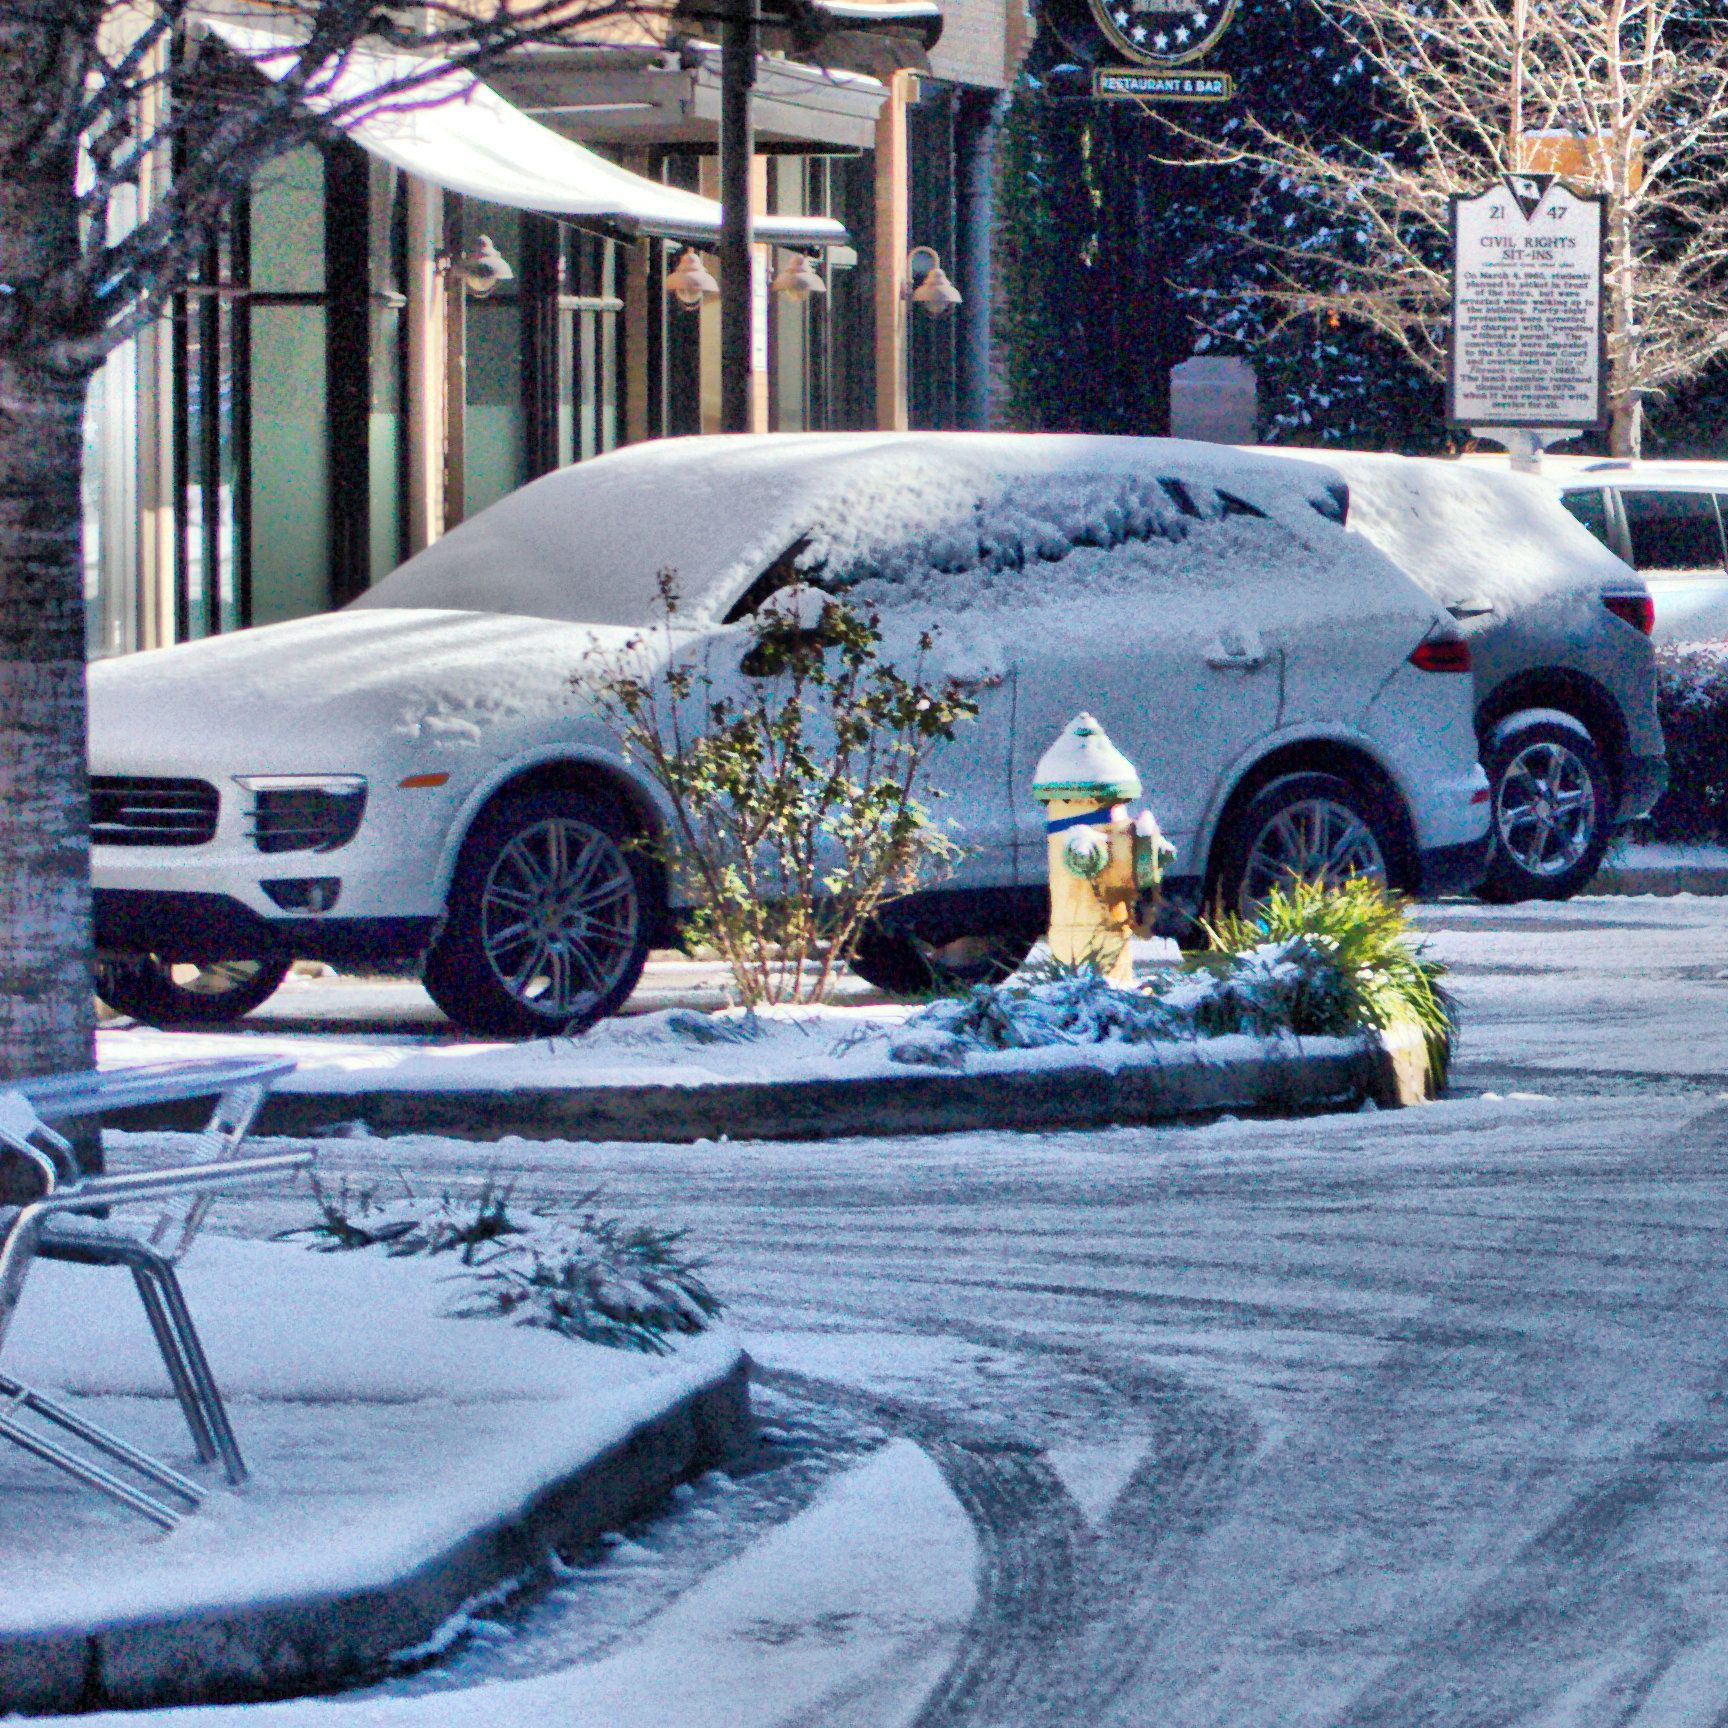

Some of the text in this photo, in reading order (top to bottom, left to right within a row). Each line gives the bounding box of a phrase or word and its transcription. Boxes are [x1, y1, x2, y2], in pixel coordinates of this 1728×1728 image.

[1100, 77, 1222, 92] RESTAURANT & BAR
[1489, 206, 1568, 219] 21 47
[1480, 237, 1576, 248] CIVIL RIGHTS
[1503, 249, 1553, 260] SIT-INS
